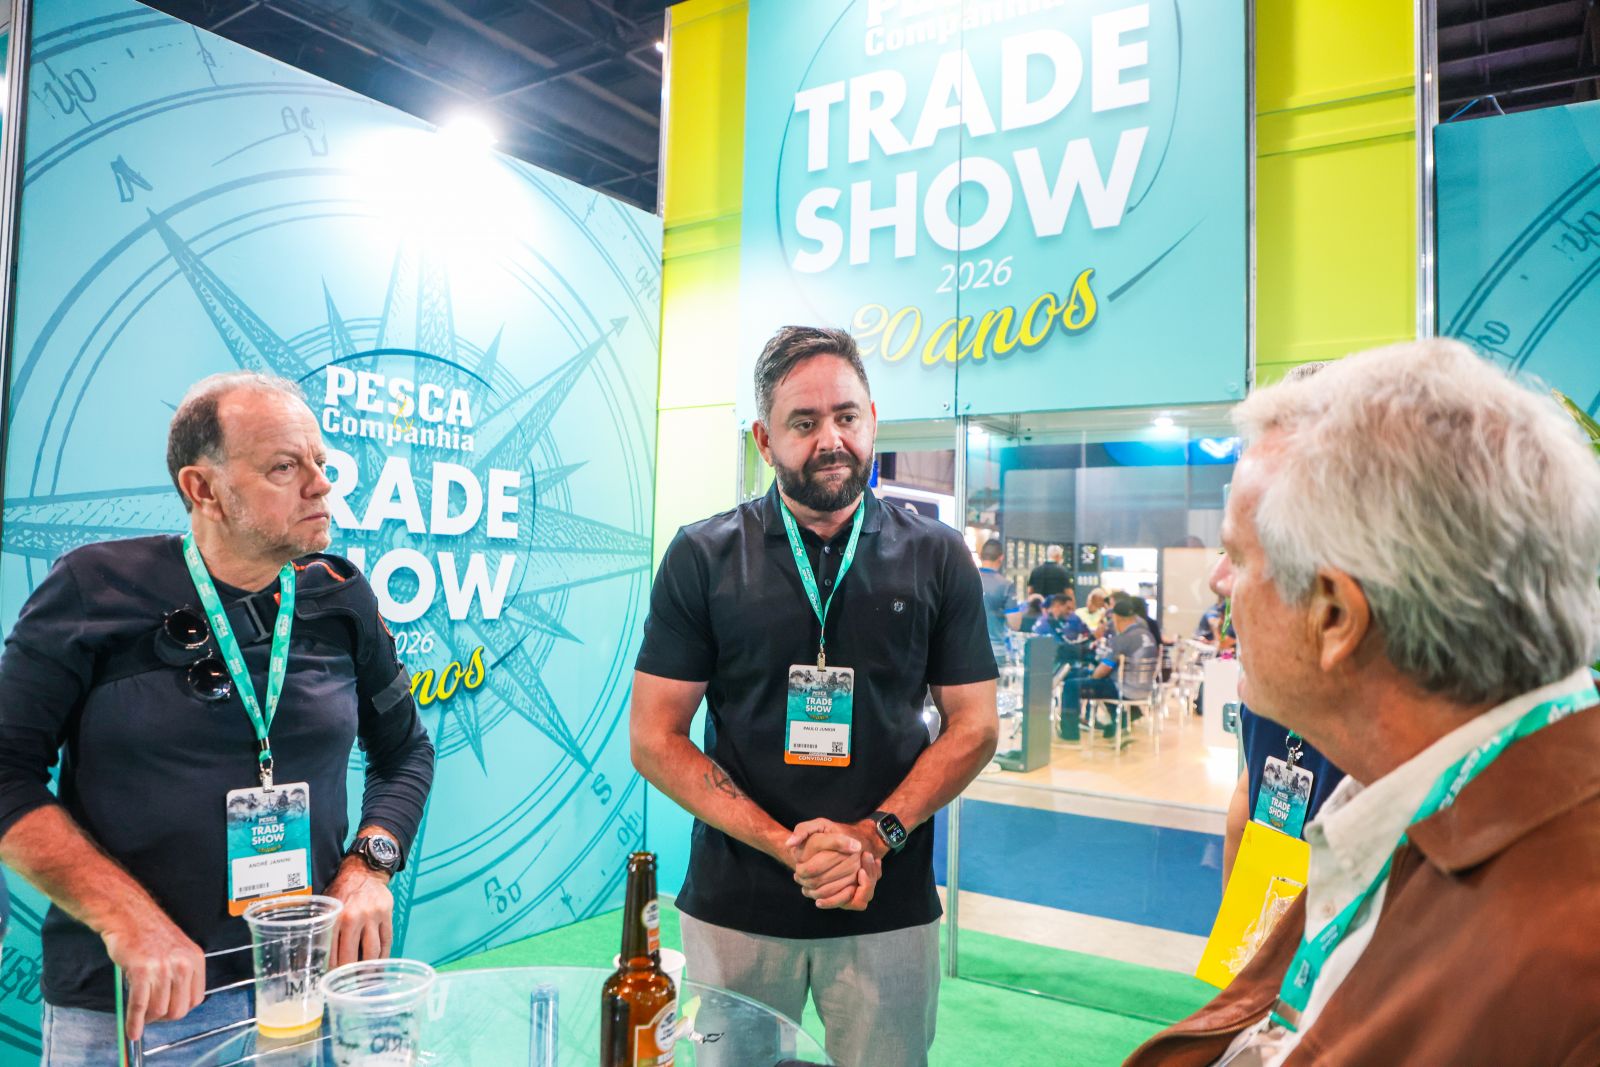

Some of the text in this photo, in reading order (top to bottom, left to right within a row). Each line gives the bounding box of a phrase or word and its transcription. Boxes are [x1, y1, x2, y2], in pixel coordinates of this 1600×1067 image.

[794, 3, 1150, 172] TRADE
[792, 127, 1150, 273] SHOW
[935, 255, 1014, 293] 2026
[921, 268, 1097, 366] anos
[323, 364, 473, 427] PESCA
[322, 406, 474, 451] Companhia
[324, 449, 521, 539] RADE
[394, 629, 435, 656] 026
[410, 645, 486, 706] nos
[805, 705, 832, 713] SHOW
[806, 696, 832, 706] TRADE
[1268, 806, 1289, 820] SHOW
[1271, 796, 1291, 813] TRADE
[251, 833, 285, 846] SHOW
[252, 823, 285, 837] TRADE
